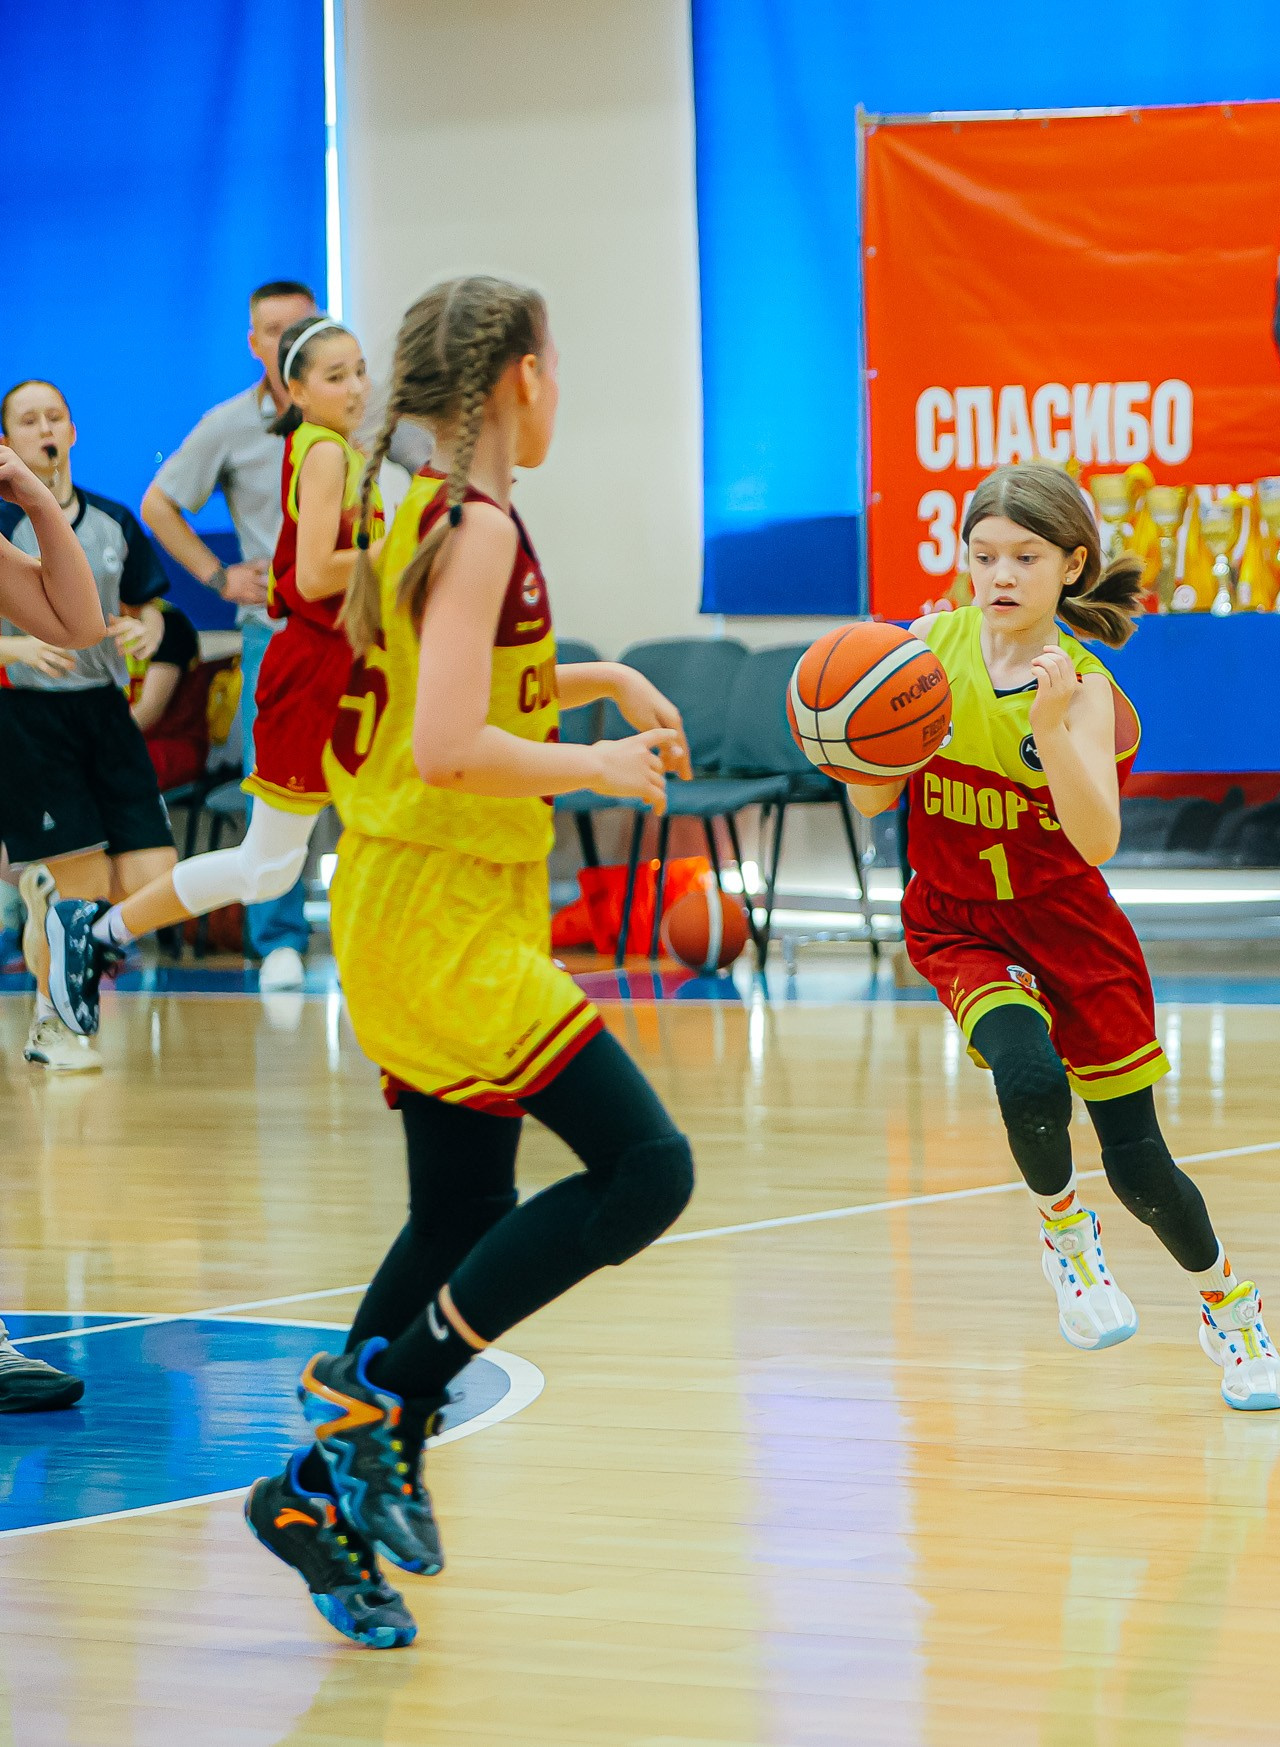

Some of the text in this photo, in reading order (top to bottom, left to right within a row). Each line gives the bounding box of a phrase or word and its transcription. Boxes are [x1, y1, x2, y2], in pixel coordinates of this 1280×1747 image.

[915, 379, 1193, 470] СПАСИБО
[890, 668, 943, 711] molten
[924, 772, 1028, 830] СШОР
[979, 843, 1014, 900] 1
